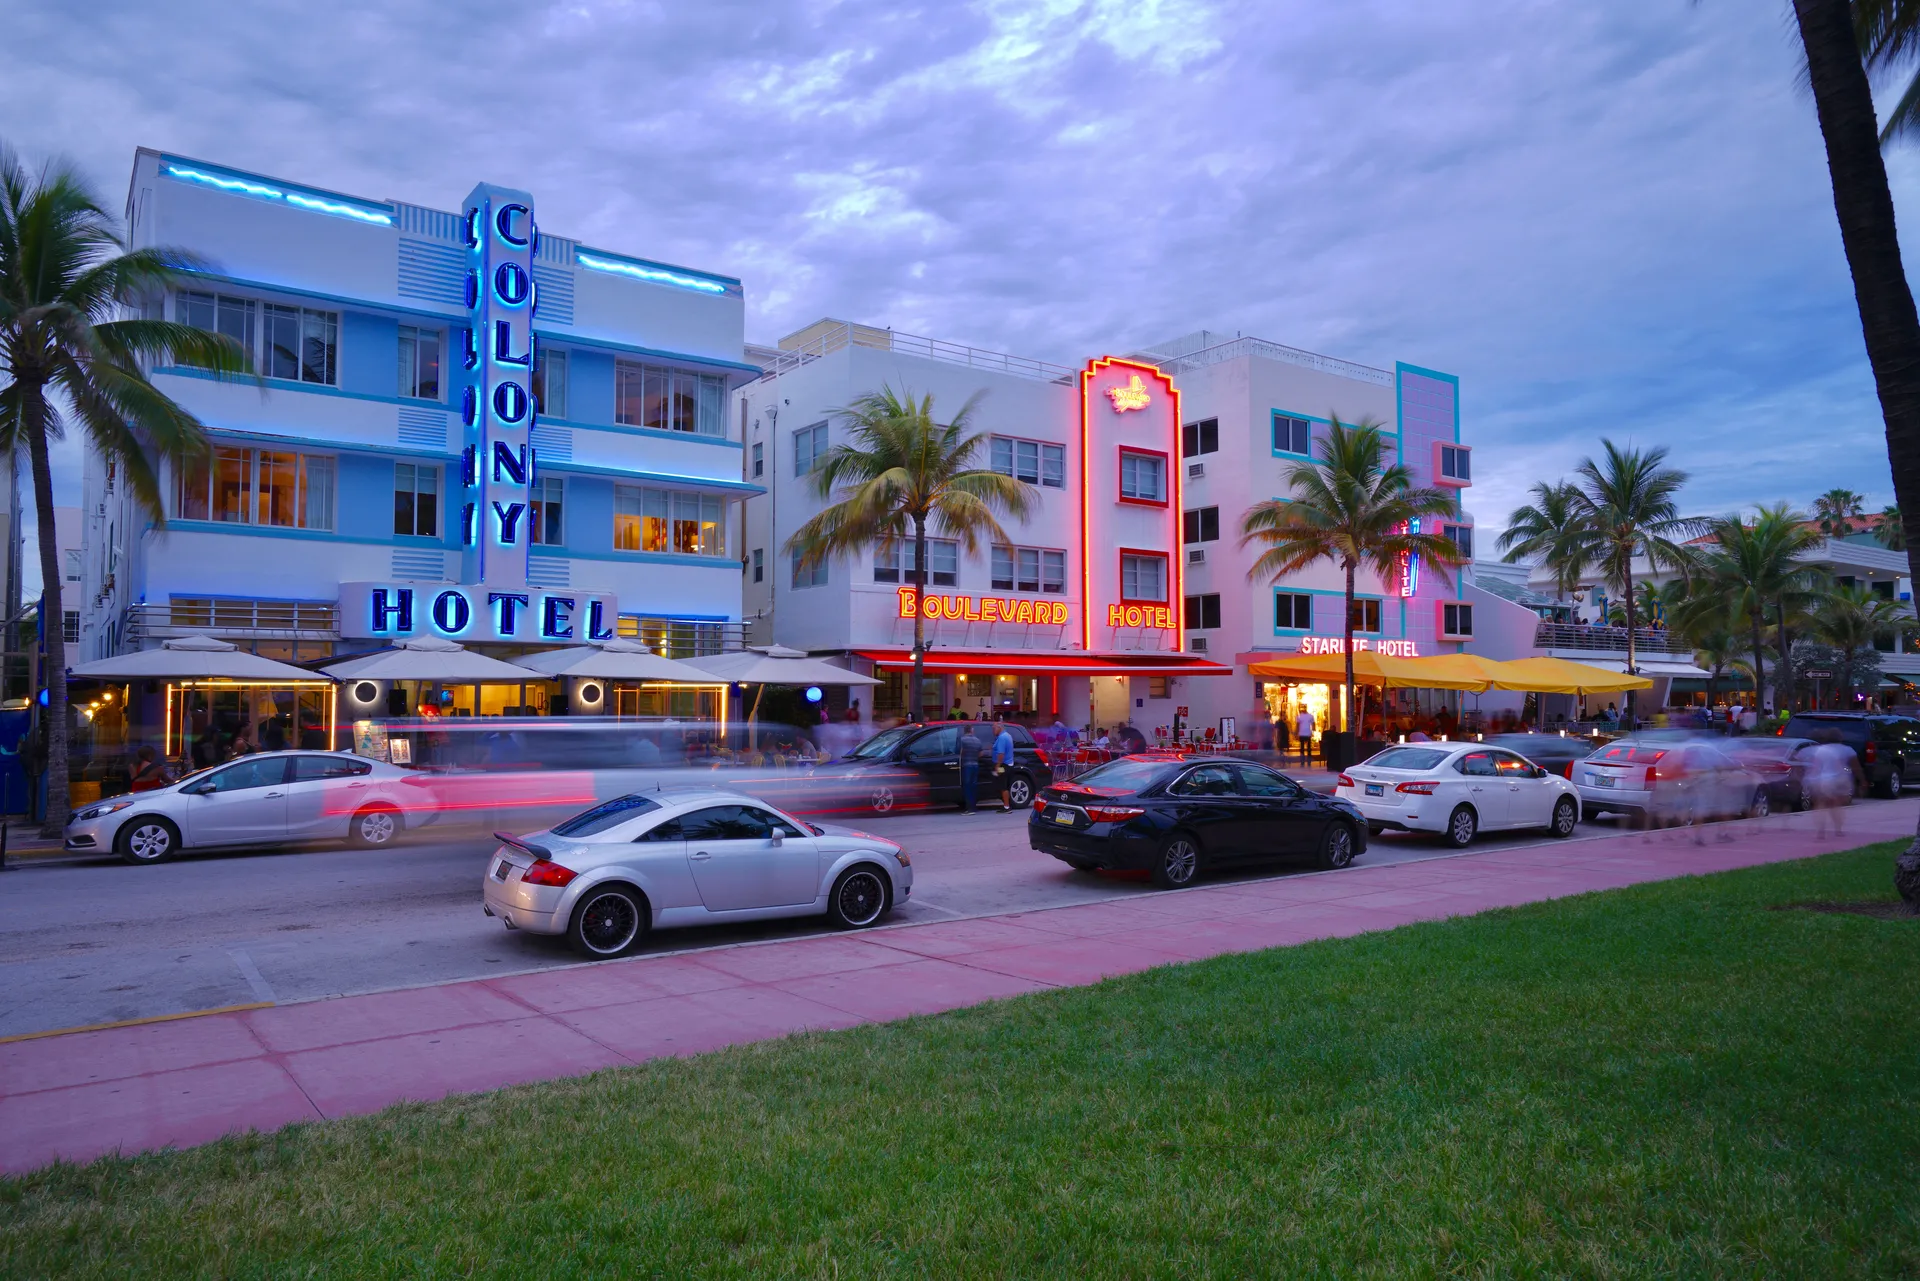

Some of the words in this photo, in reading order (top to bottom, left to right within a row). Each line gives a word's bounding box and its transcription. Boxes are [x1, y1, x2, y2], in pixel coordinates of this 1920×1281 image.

[491, 203, 529, 544] COLONY
[1400, 518, 1410, 597] STLITE
[372, 588, 613, 640] HOTEL
[897, 587, 1068, 625] BOULEVARD
[1108, 604, 1177, 629] HOTEL
[1301, 637, 1369, 654] STARLTE
[1377, 640, 1419, 657] HOTEL
